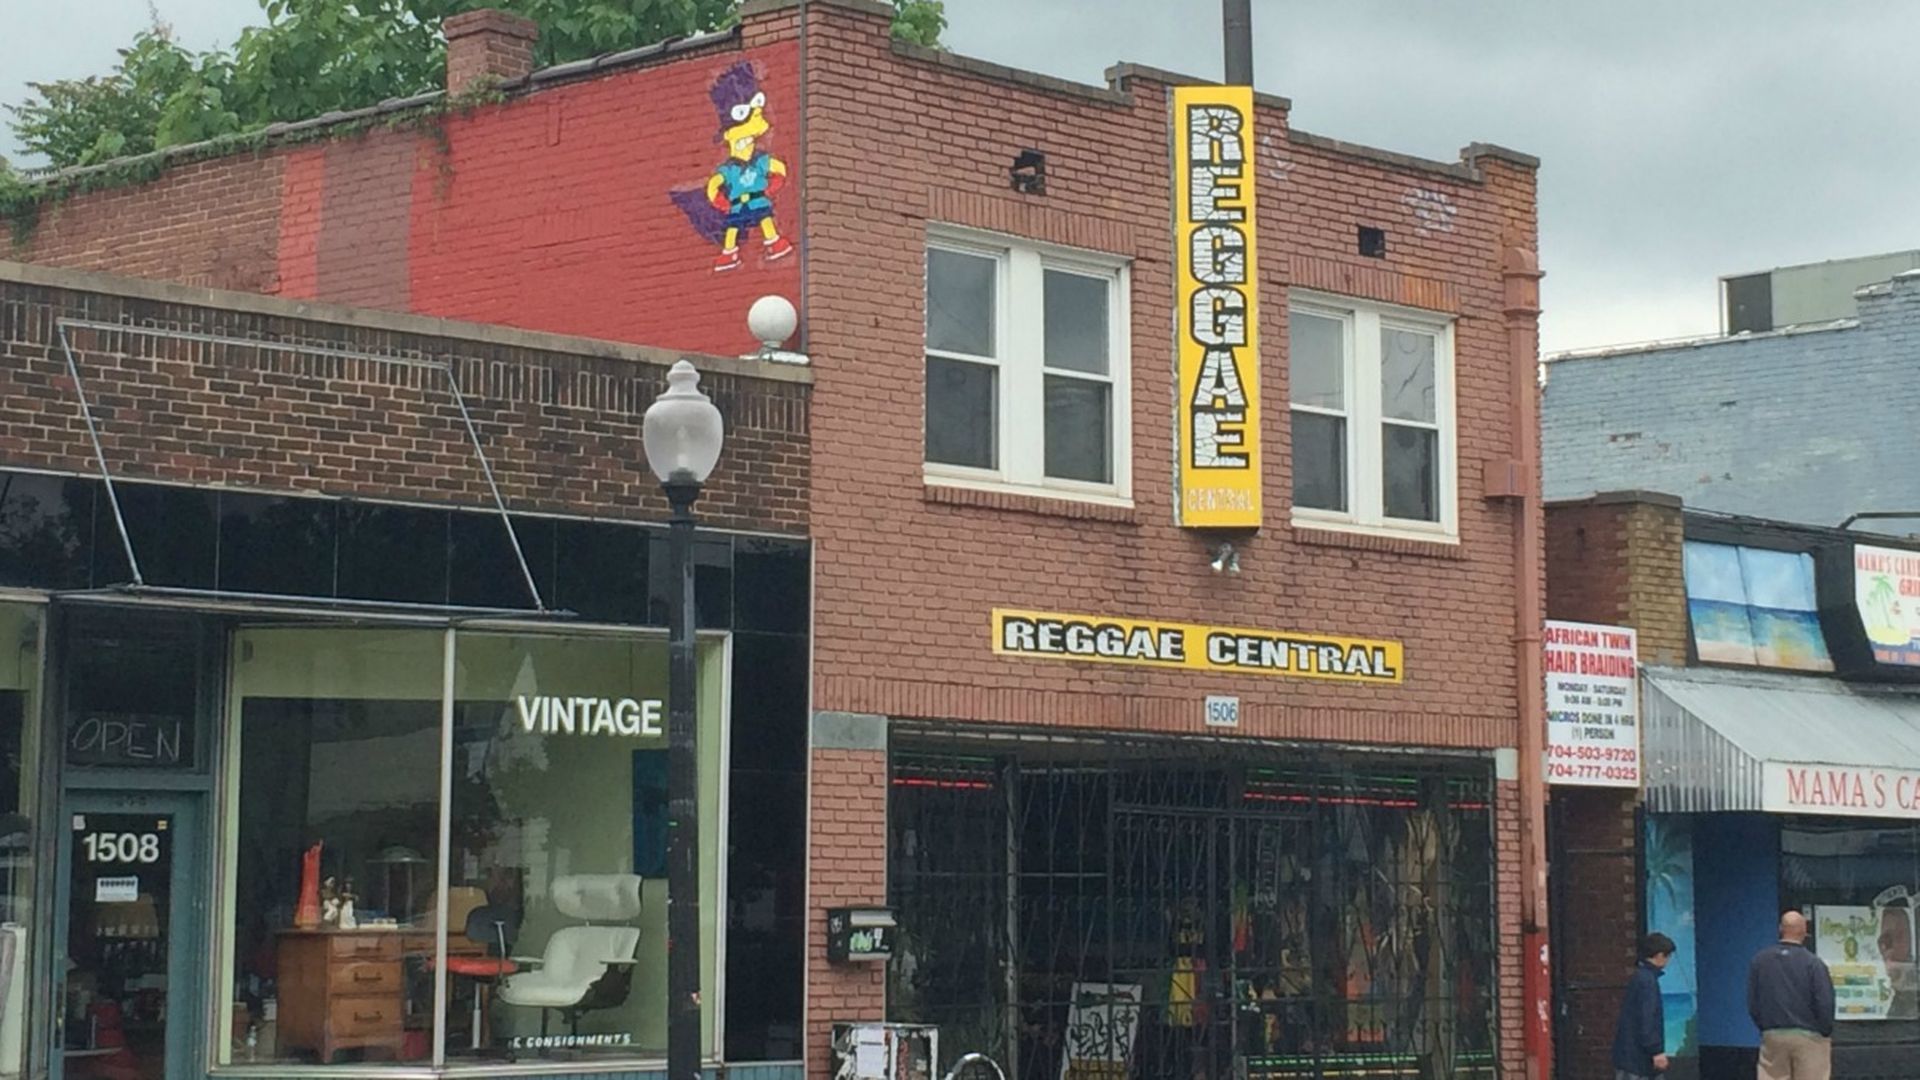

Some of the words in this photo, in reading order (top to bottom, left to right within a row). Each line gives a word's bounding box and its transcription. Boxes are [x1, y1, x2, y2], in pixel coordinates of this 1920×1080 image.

[1187, 104, 1249, 469] REGGAE
[1188, 488, 1254, 511] CENTRAL
[1002, 616, 1184, 661] REGGAE
[1208, 633, 1395, 677] CENTRAL
[1545, 627, 1598, 647] AFRICAN
[1601, 632, 1631, 650] TWIN
[1545, 650, 1576, 673] HAIR
[1580, 652, 1634, 678] BRAIDING
[518, 696, 662, 735] VINTAGE
[1208, 701, 1237, 722] 1506
[1582, 712, 1602, 725] DONE
[72, 718, 180, 761] OPEN
[1584, 727, 1614, 739] PERSON
[1548, 745, 1636, 762] 704-503-9720
[1548, 764, 1636, 780] 704-777-0325
[1787, 769, 1886, 808] MAMA'S
[83, 832, 160, 863] 1508
[527, 1033, 632, 1048] CONSIGNMENTS
